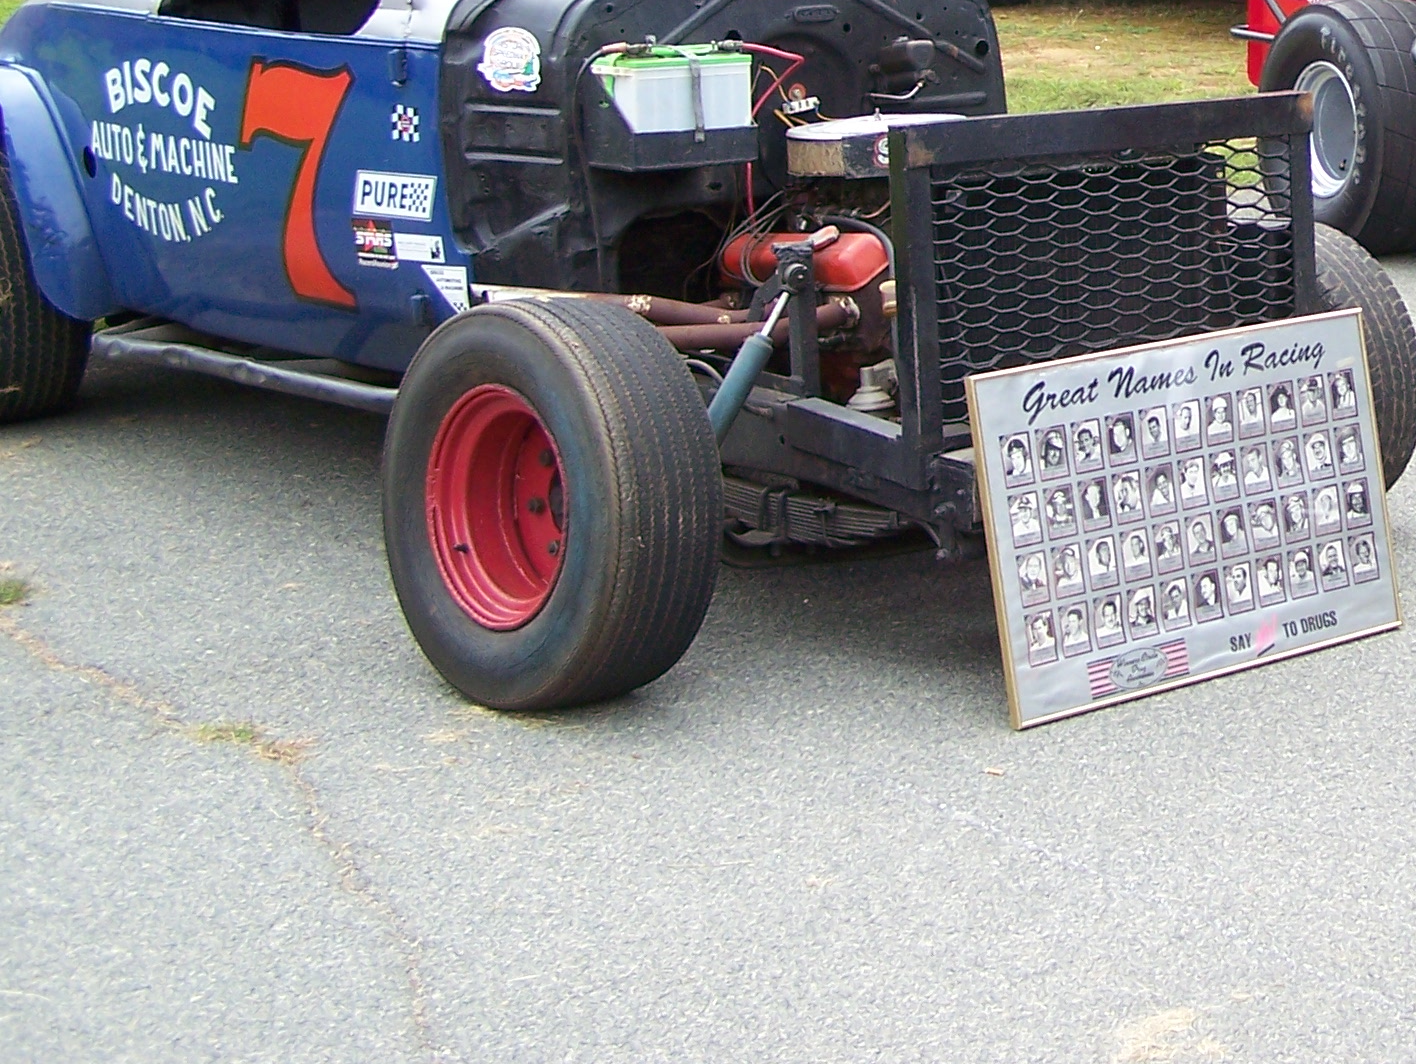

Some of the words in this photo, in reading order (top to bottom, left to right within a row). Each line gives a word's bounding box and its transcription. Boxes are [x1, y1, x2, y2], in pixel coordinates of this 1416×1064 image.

[104, 57, 217, 141] BISCOE
[91, 120, 135, 167] AUTO
[136, 123, 148, 174] &
[150, 133, 239, 185] MACHINE
[241, 55, 357, 311] 7
[111, 172, 193, 244] DENTON,
[360, 179, 409, 209] PURE
[1021, 380, 1100, 425] Great
[1107, 365, 1198, 403] Names
[1204, 349, 1233, 382] In
[1240, 338, 1327, 373] Racing
[1229, 632, 1252, 652] SAY
[1282, 620, 1299, 638] TO
[1300, 610, 1339, 634] DRUGS
